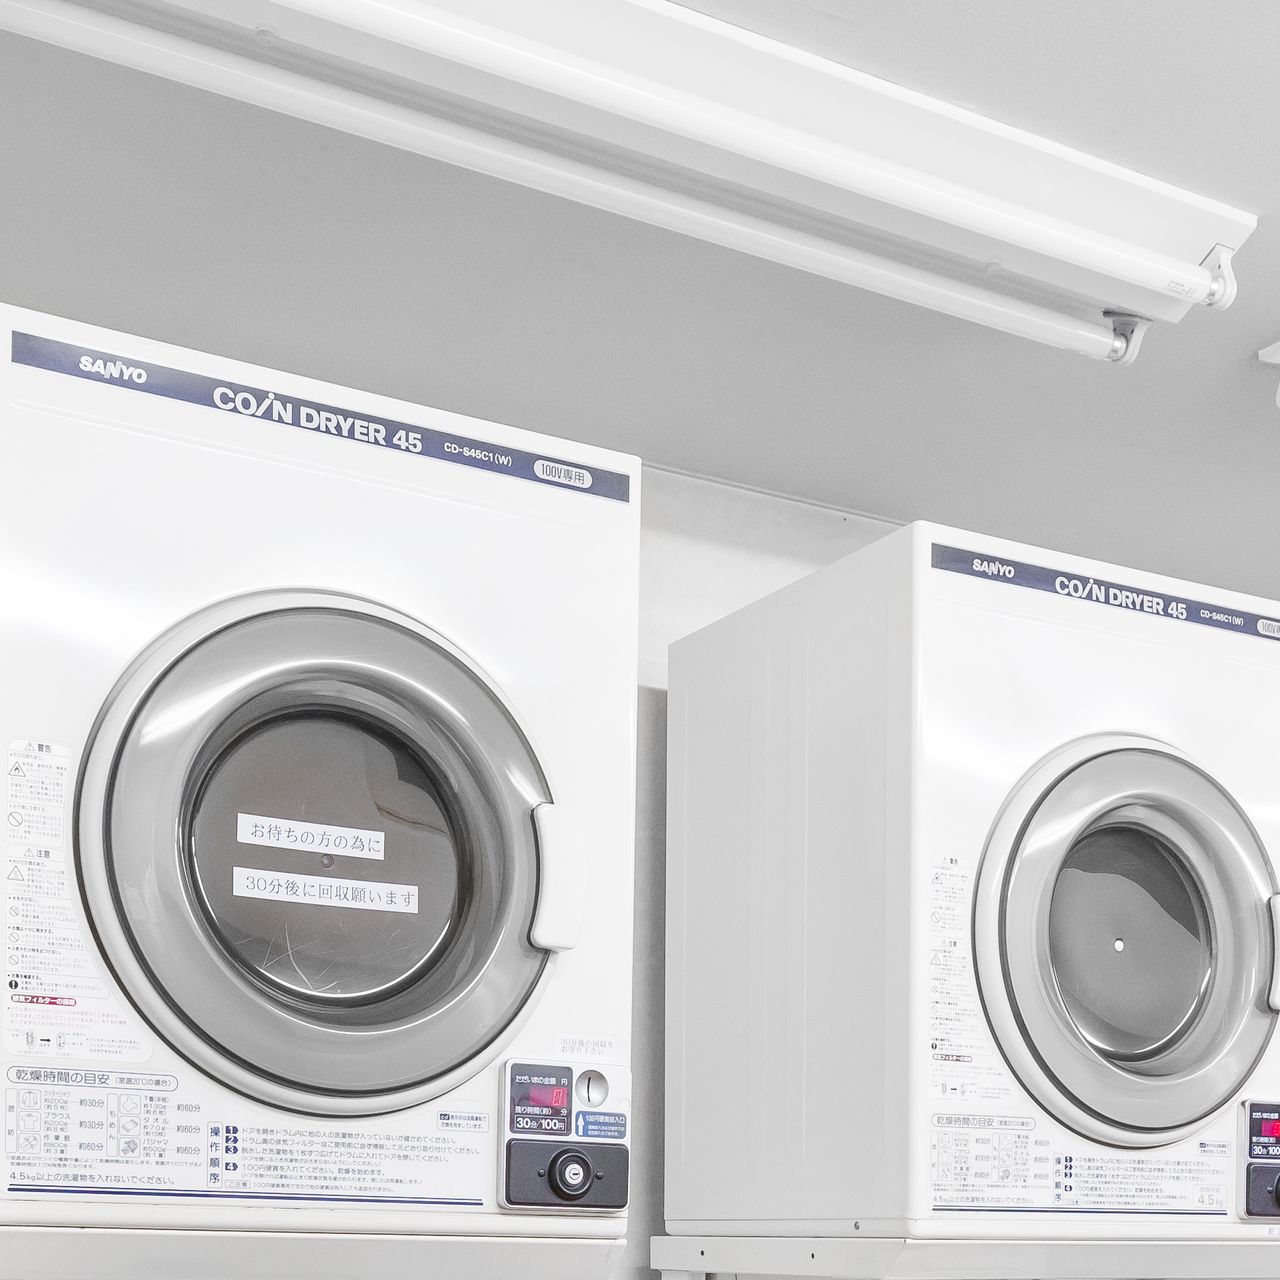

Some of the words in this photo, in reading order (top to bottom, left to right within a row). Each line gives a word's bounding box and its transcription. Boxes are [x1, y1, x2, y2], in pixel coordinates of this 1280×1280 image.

[78, 355, 147, 384] SANYO
[300, 405, 386, 446] DRYER
[392, 430, 422, 453] 45
[444, 442, 512, 467] CD-S45C1(W)
[540, 462, 585, 485] 100V専用
[972, 558, 1015, 578] SANYO
[1109, 587, 1165, 615] DRYER
[1167, 602, 1188, 620] 45
[251, 822, 381, 853] お待ちの方の為に
[246, 875, 415, 907] 30分後に回収願います
[15, 1069, 110, 1086] 乾燥時間の目安
[516, 1117, 565, 1131] 30分/100円
[209, 1126, 221, 1184] 操作順序
